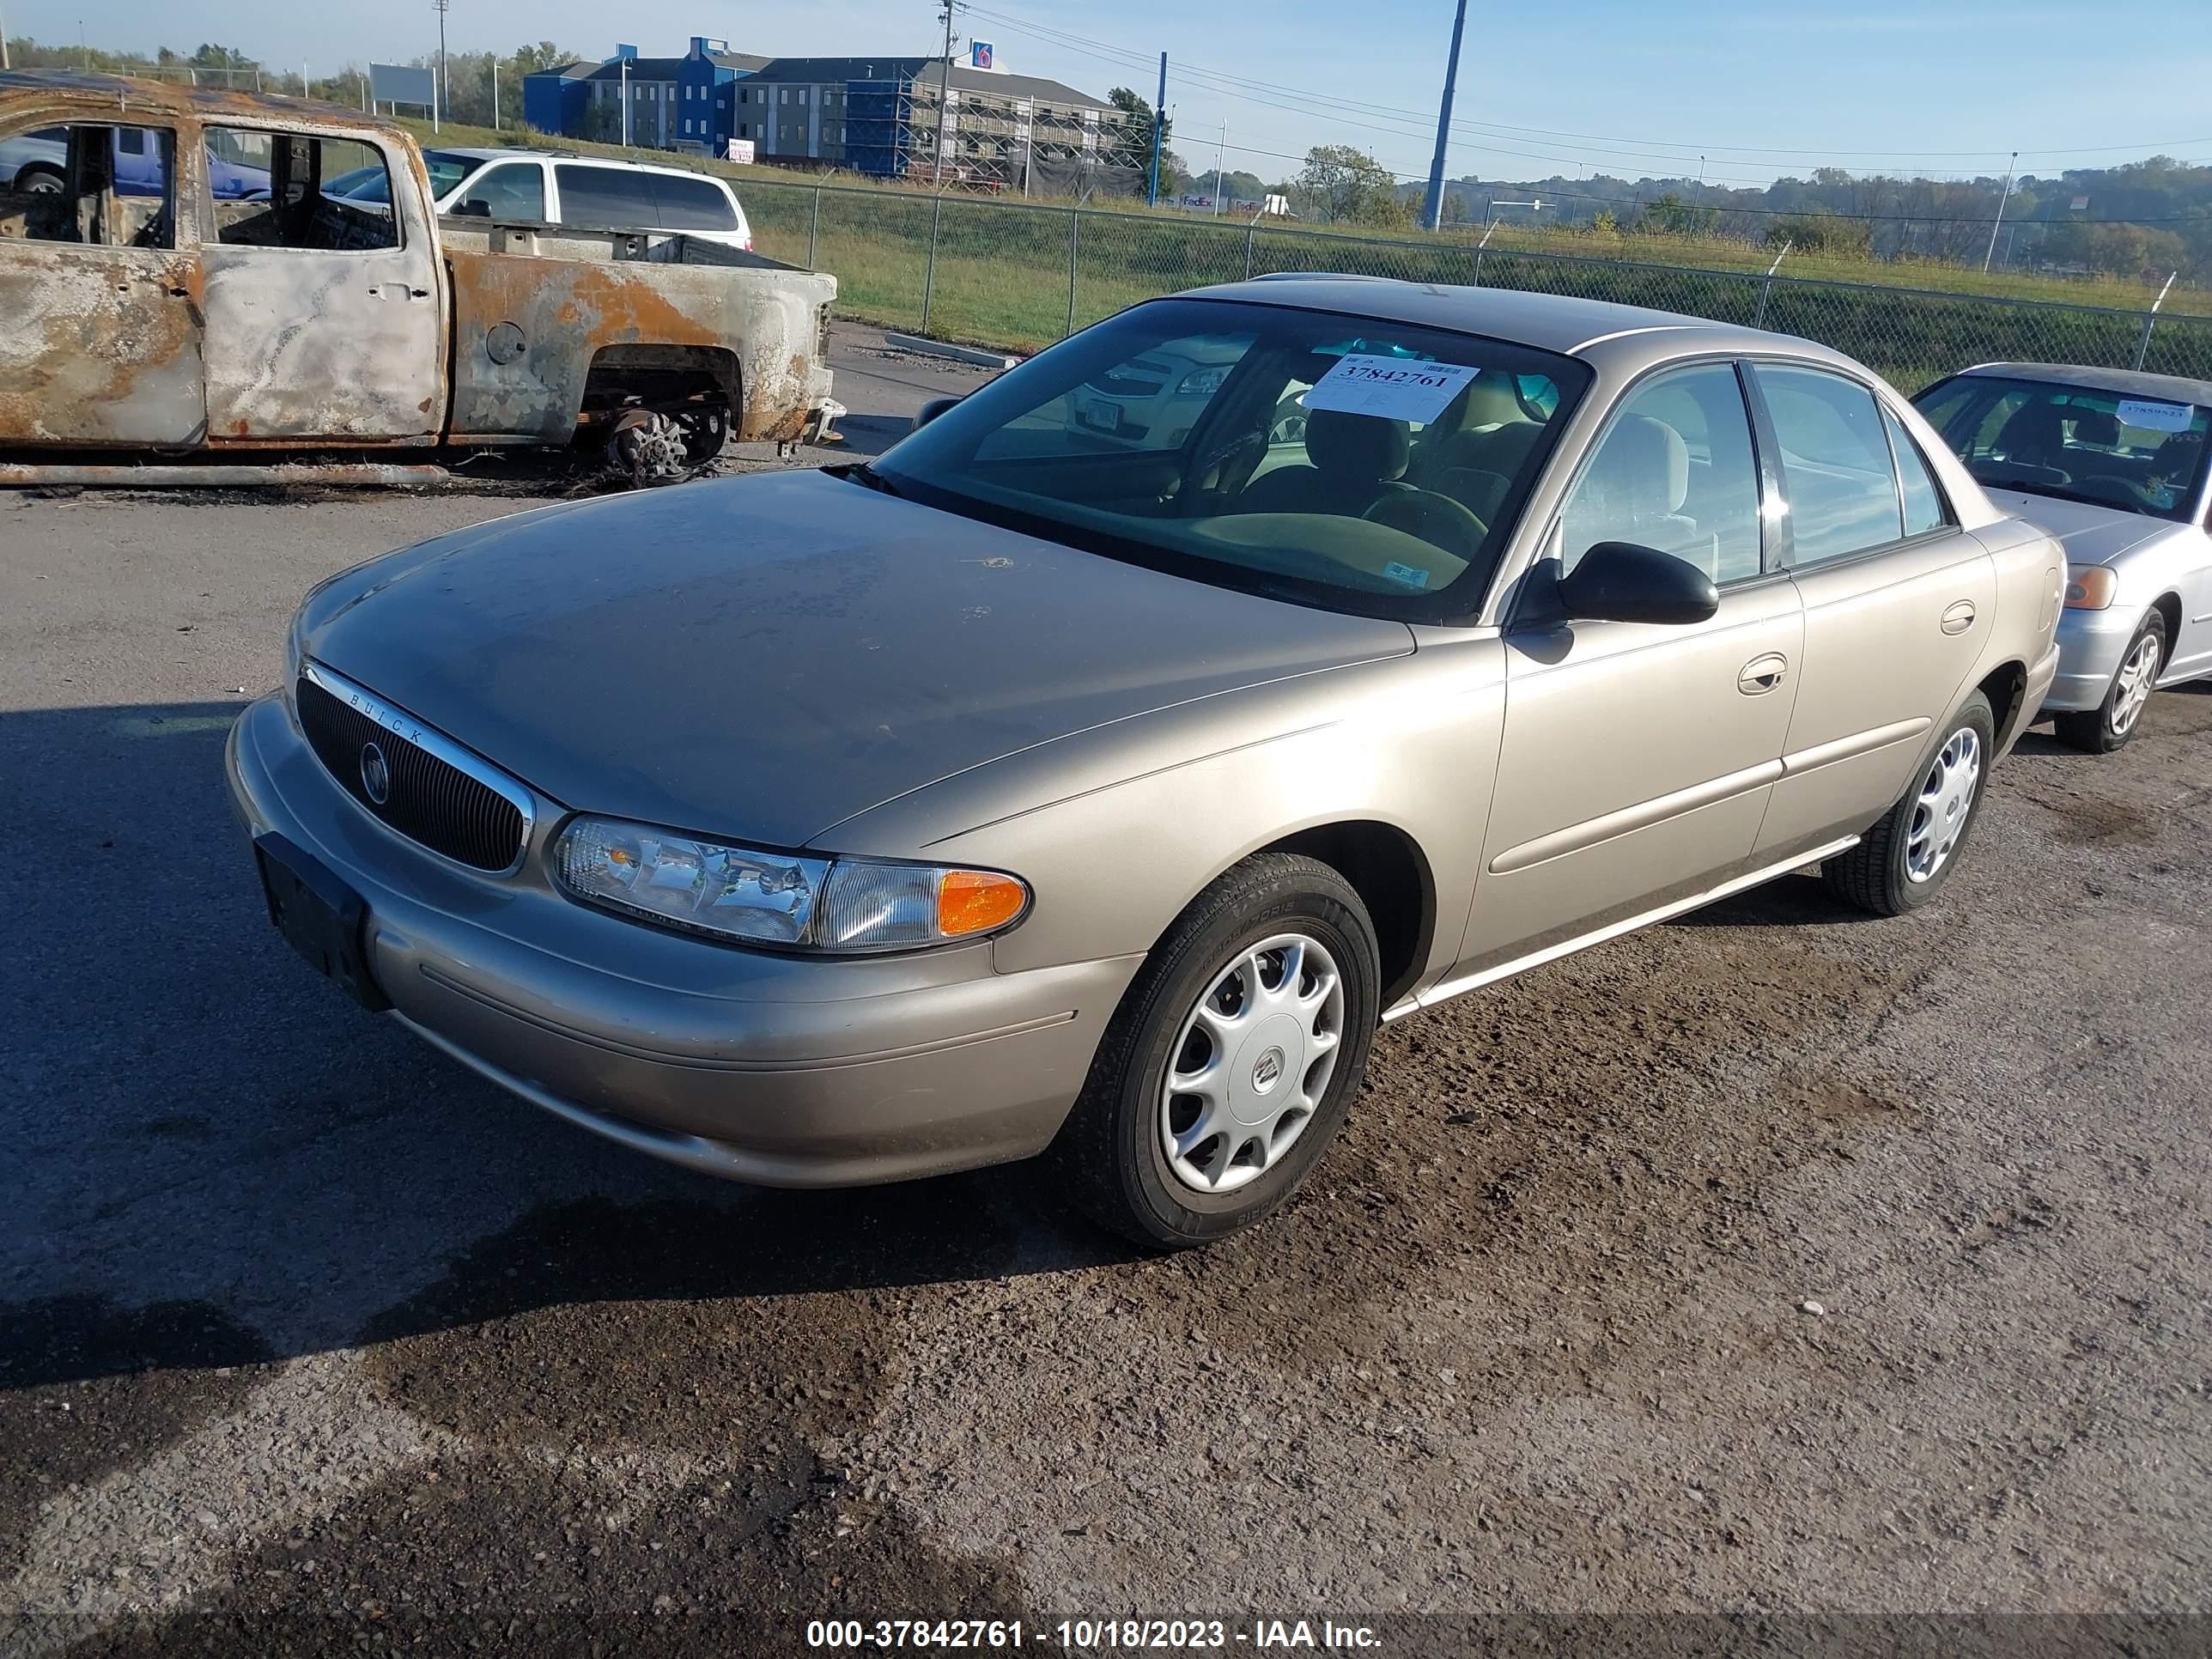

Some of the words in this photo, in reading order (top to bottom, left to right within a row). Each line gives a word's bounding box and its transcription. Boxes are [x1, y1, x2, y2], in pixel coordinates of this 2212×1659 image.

[977, 45, 991, 69] 6
[1183, 196, 1213, 208] FedEx
[1339, 366, 1449, 388] 37842761
[349, 694, 423, 744] BUICK
